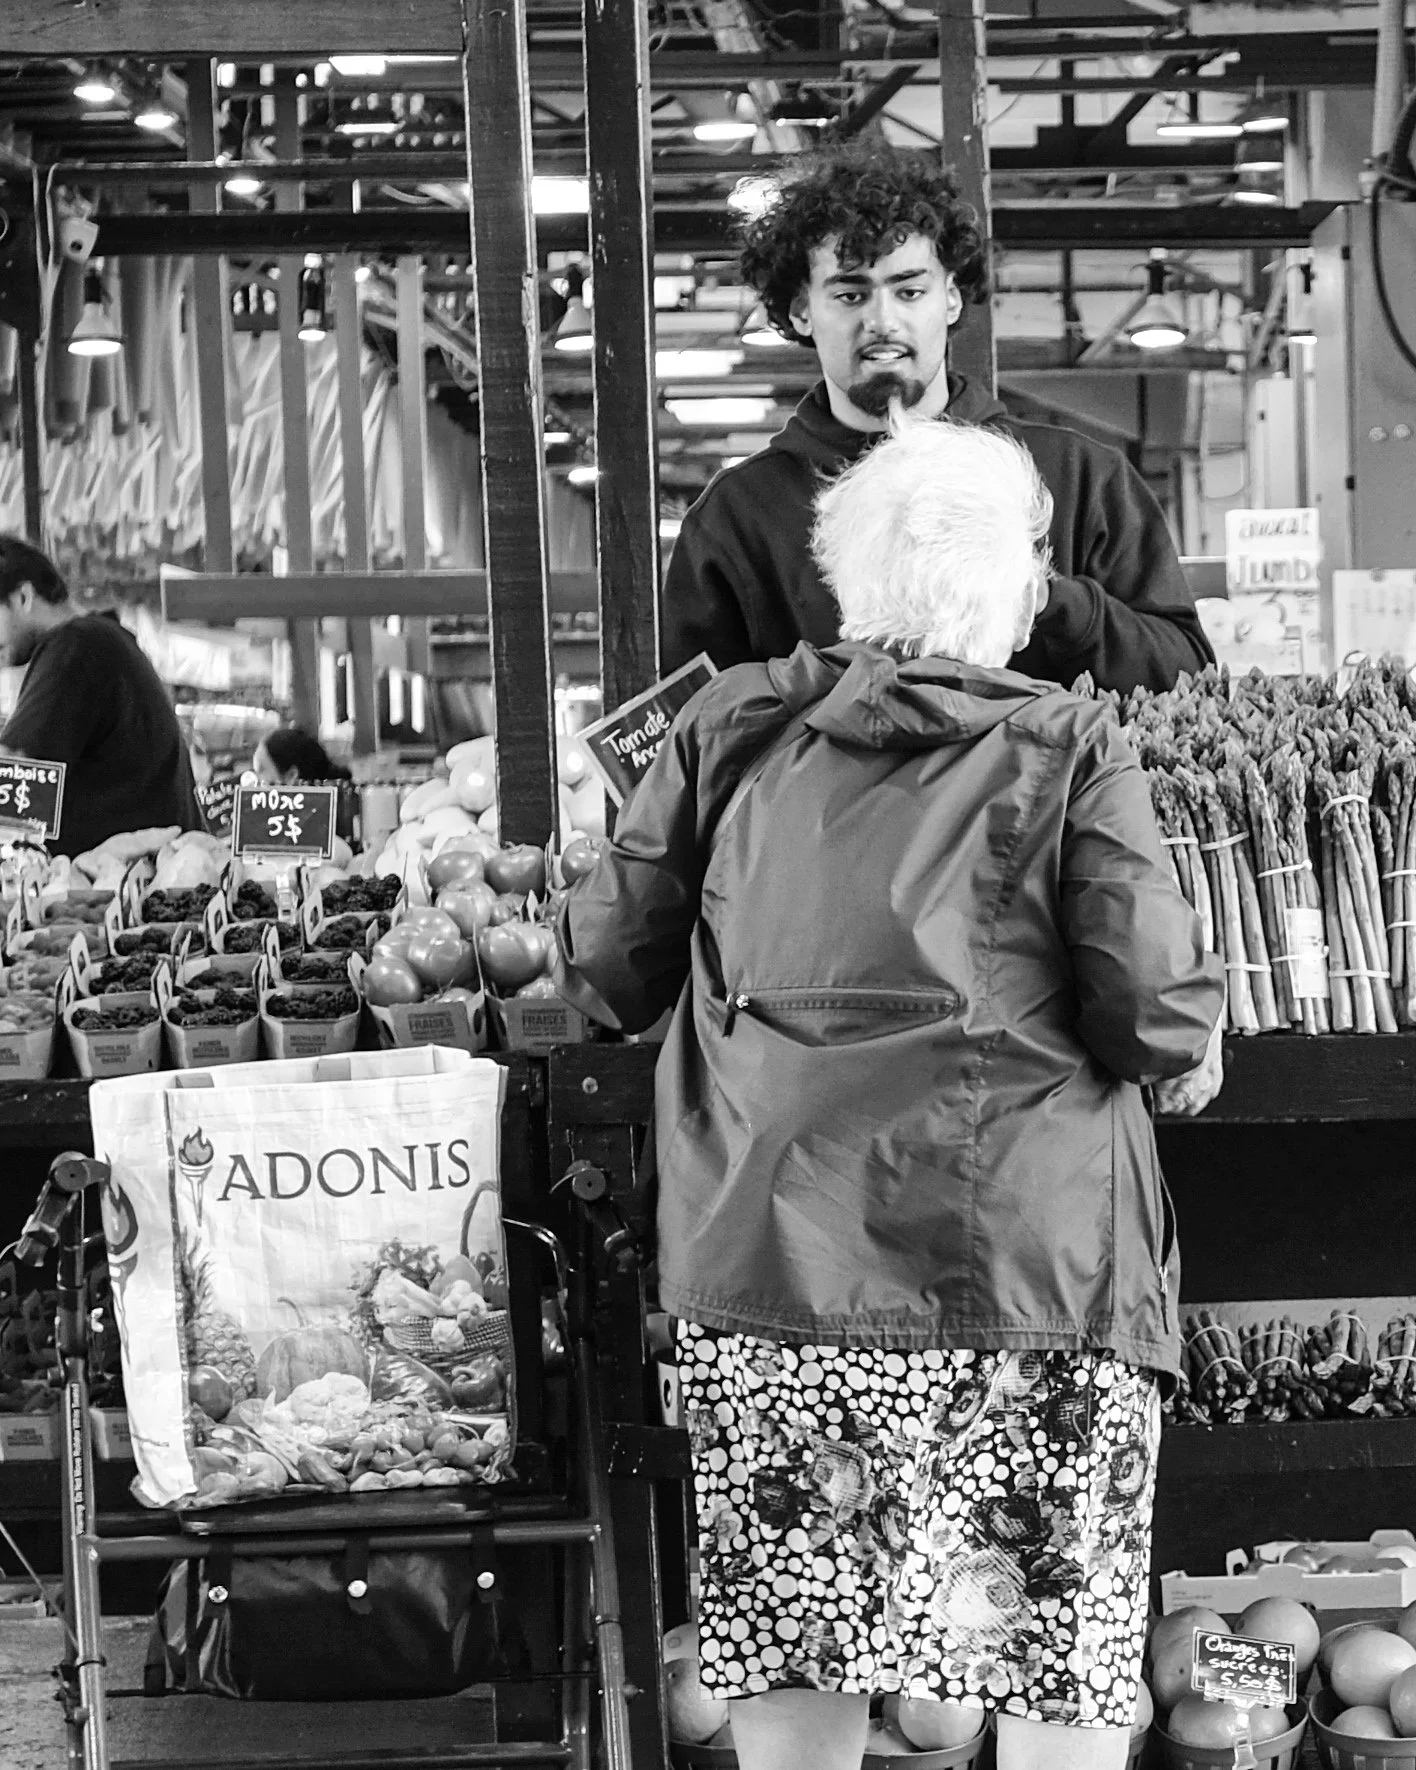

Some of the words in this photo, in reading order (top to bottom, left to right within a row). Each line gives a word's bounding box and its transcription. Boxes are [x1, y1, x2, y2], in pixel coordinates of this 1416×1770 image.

[600, 710, 670, 757] Tomate
[267, 813, 302, 845] 5$
[216, 1138, 470, 1202] ADONIS
